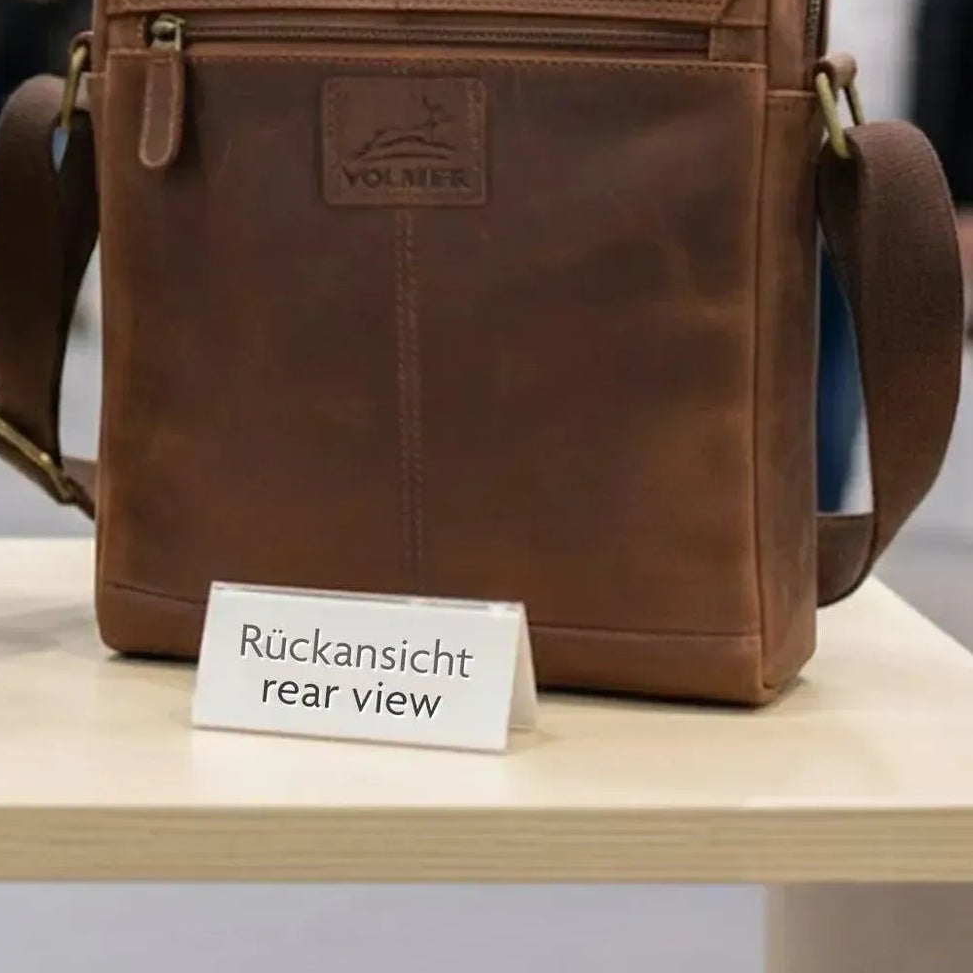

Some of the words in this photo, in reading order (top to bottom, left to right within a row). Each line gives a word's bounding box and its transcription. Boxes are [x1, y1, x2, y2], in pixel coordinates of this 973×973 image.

[239, 623, 474, 678] Rückansicht
[261, 678, 340, 709] rear
[352, 681, 442, 719] view
